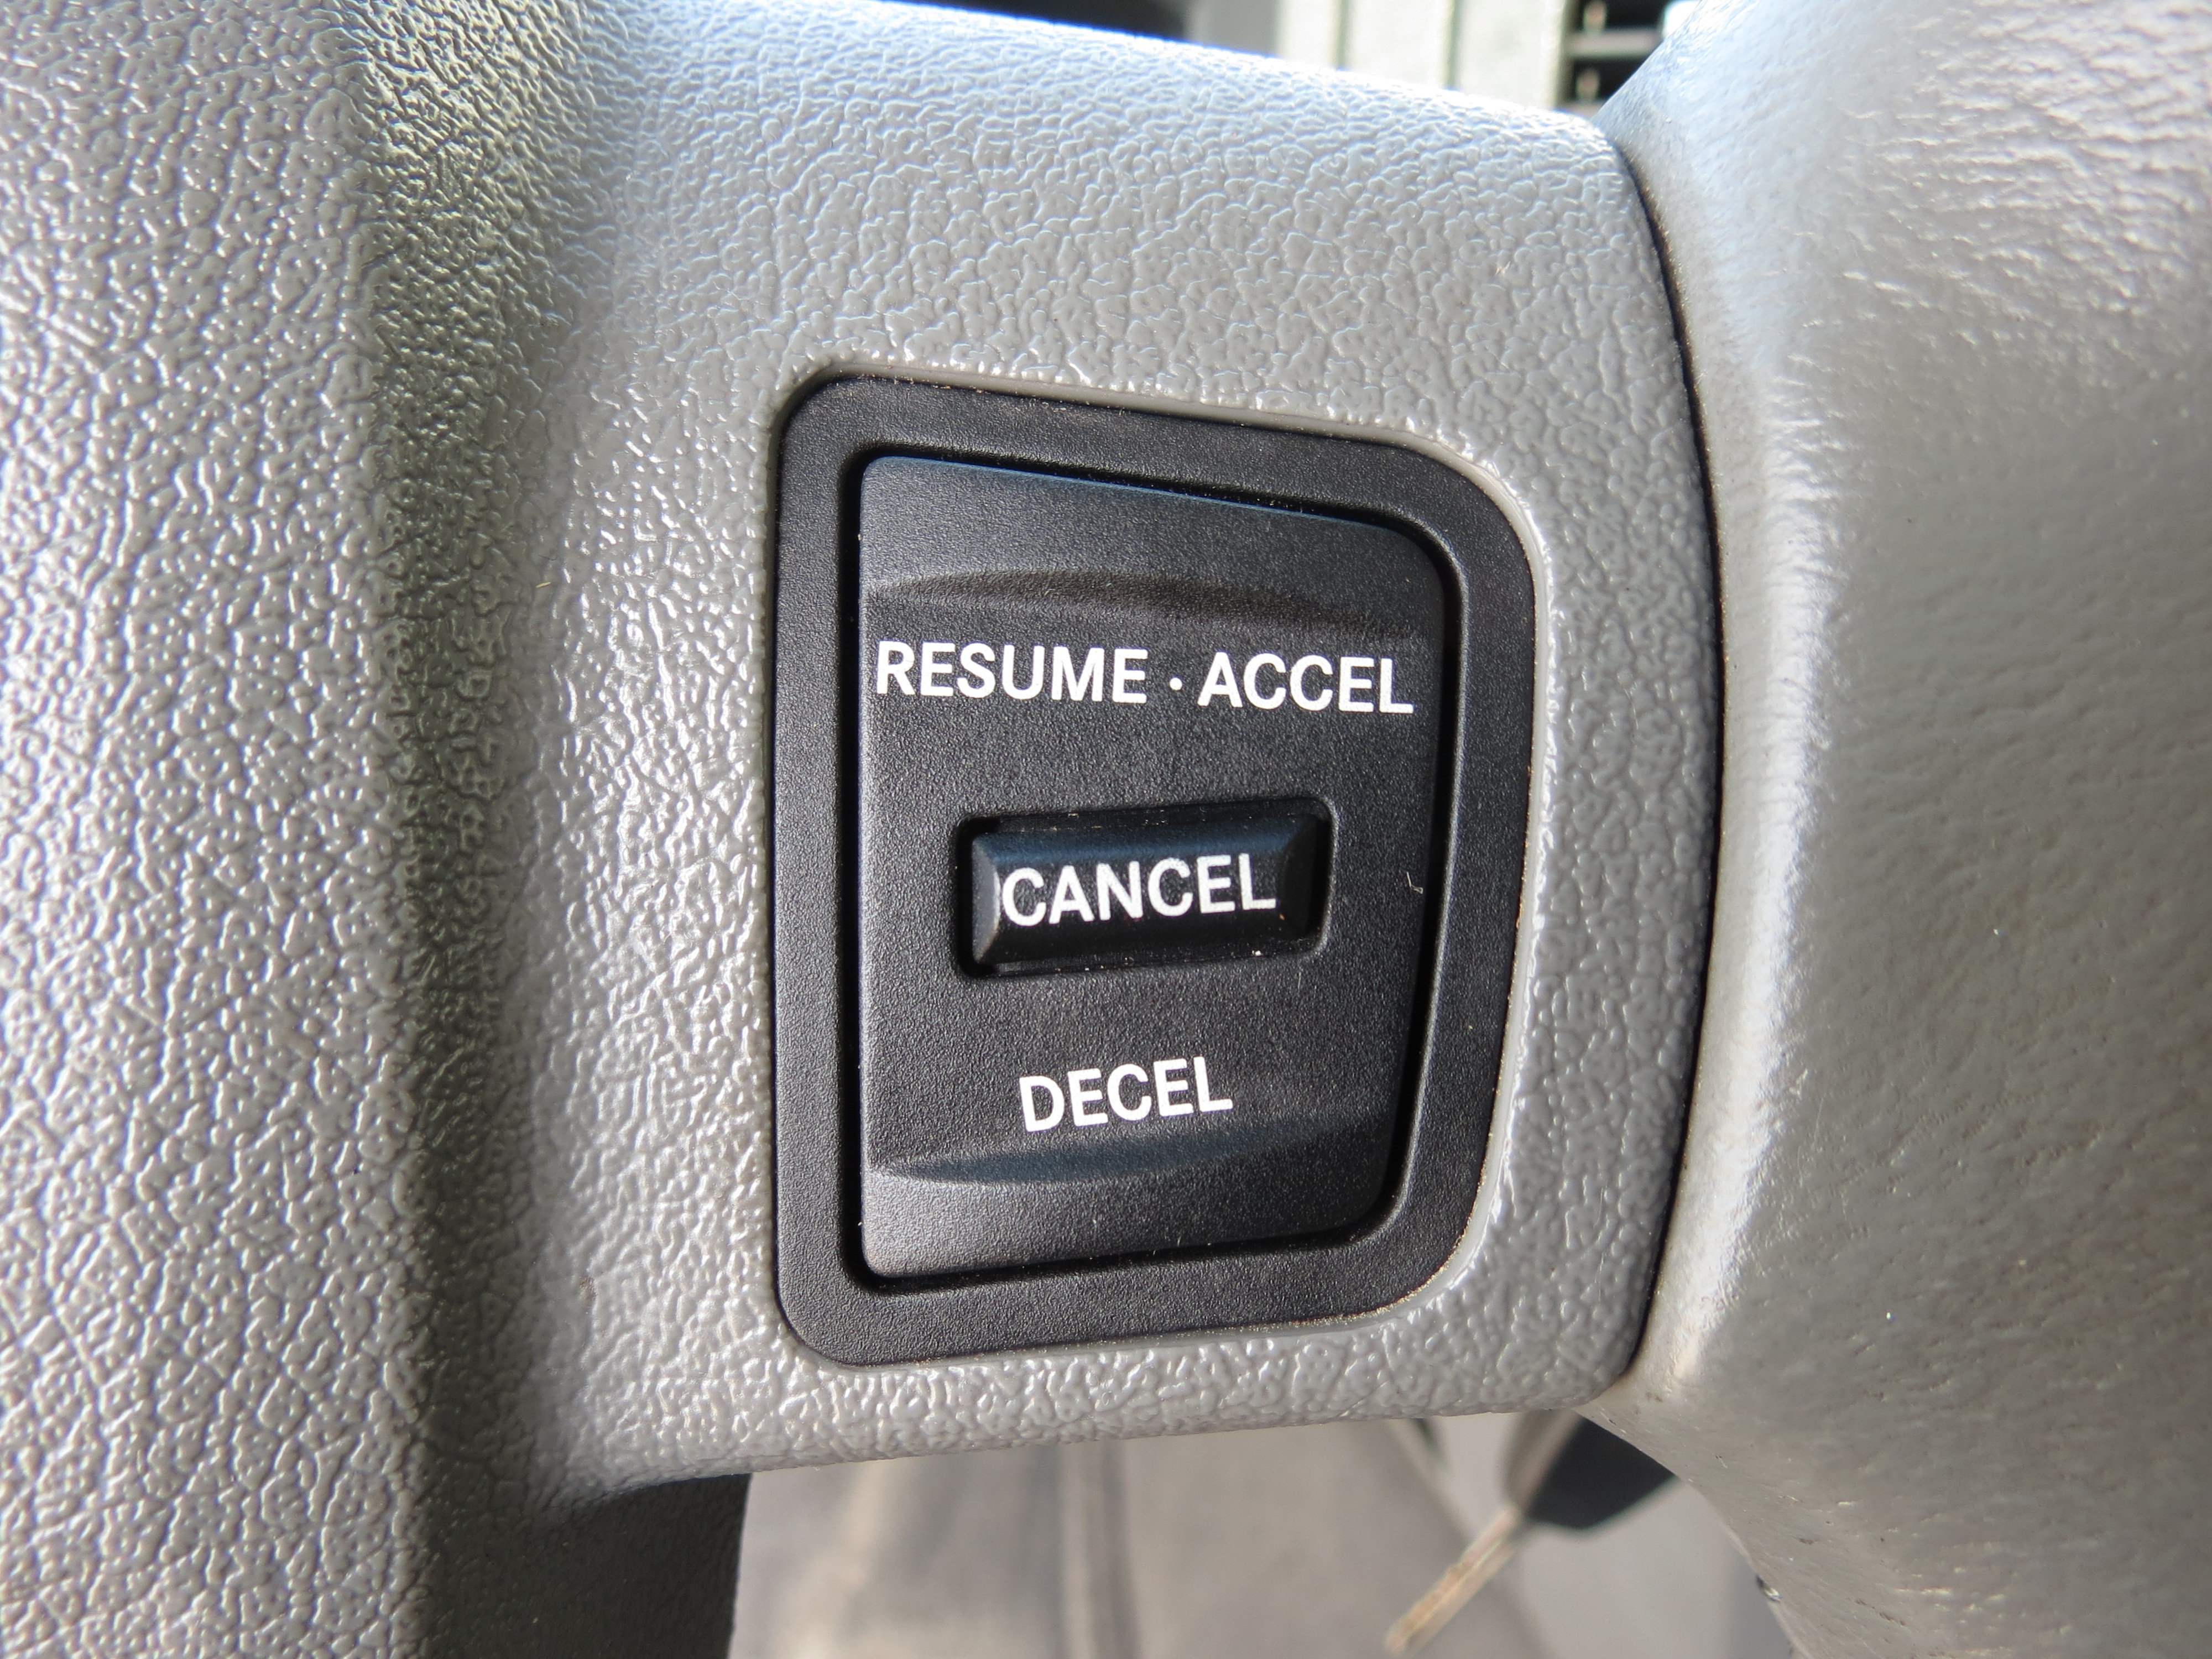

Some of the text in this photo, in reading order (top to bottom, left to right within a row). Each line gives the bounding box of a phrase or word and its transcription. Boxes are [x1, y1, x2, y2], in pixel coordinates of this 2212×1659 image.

[875, 640, 1148, 704] RESUME
[1197, 652, 1414, 714] ACCEL
[1001, 853, 1276, 926] CANCEL
[1019, 1056, 1233, 1132] DECEL
